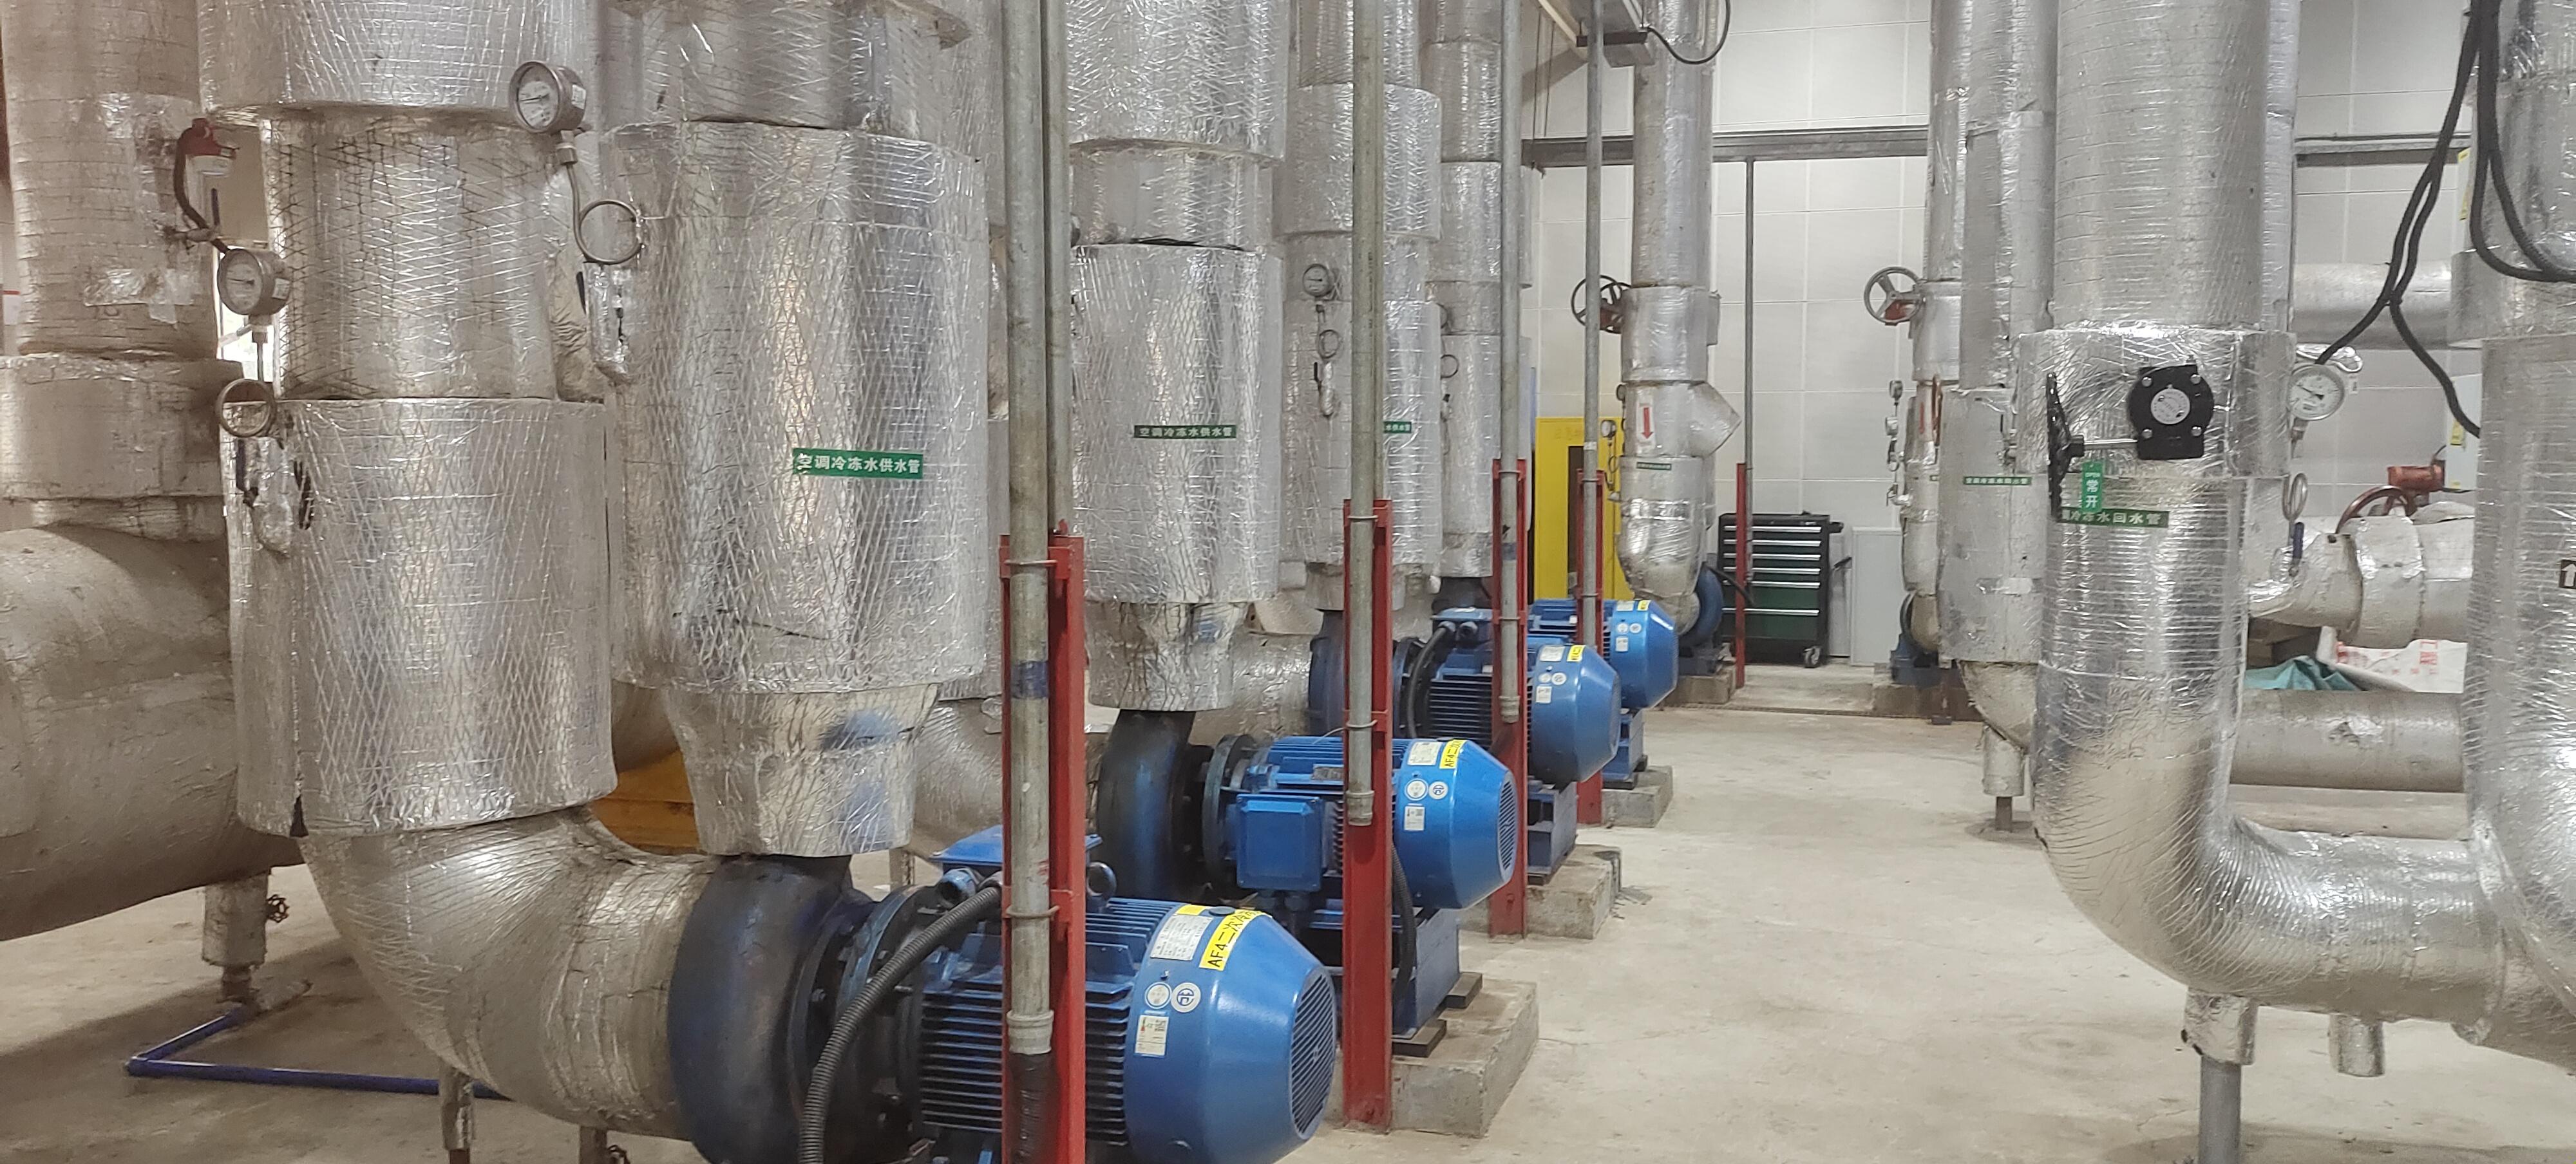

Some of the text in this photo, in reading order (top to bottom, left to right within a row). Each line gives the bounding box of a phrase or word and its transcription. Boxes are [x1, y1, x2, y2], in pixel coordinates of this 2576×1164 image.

[797, 453, 921, 474] 空调冷冻水供水管
[2086, 479, 2100, 508] 常开
[2061, 509, 2162, 525] 调冷冻水回水管
